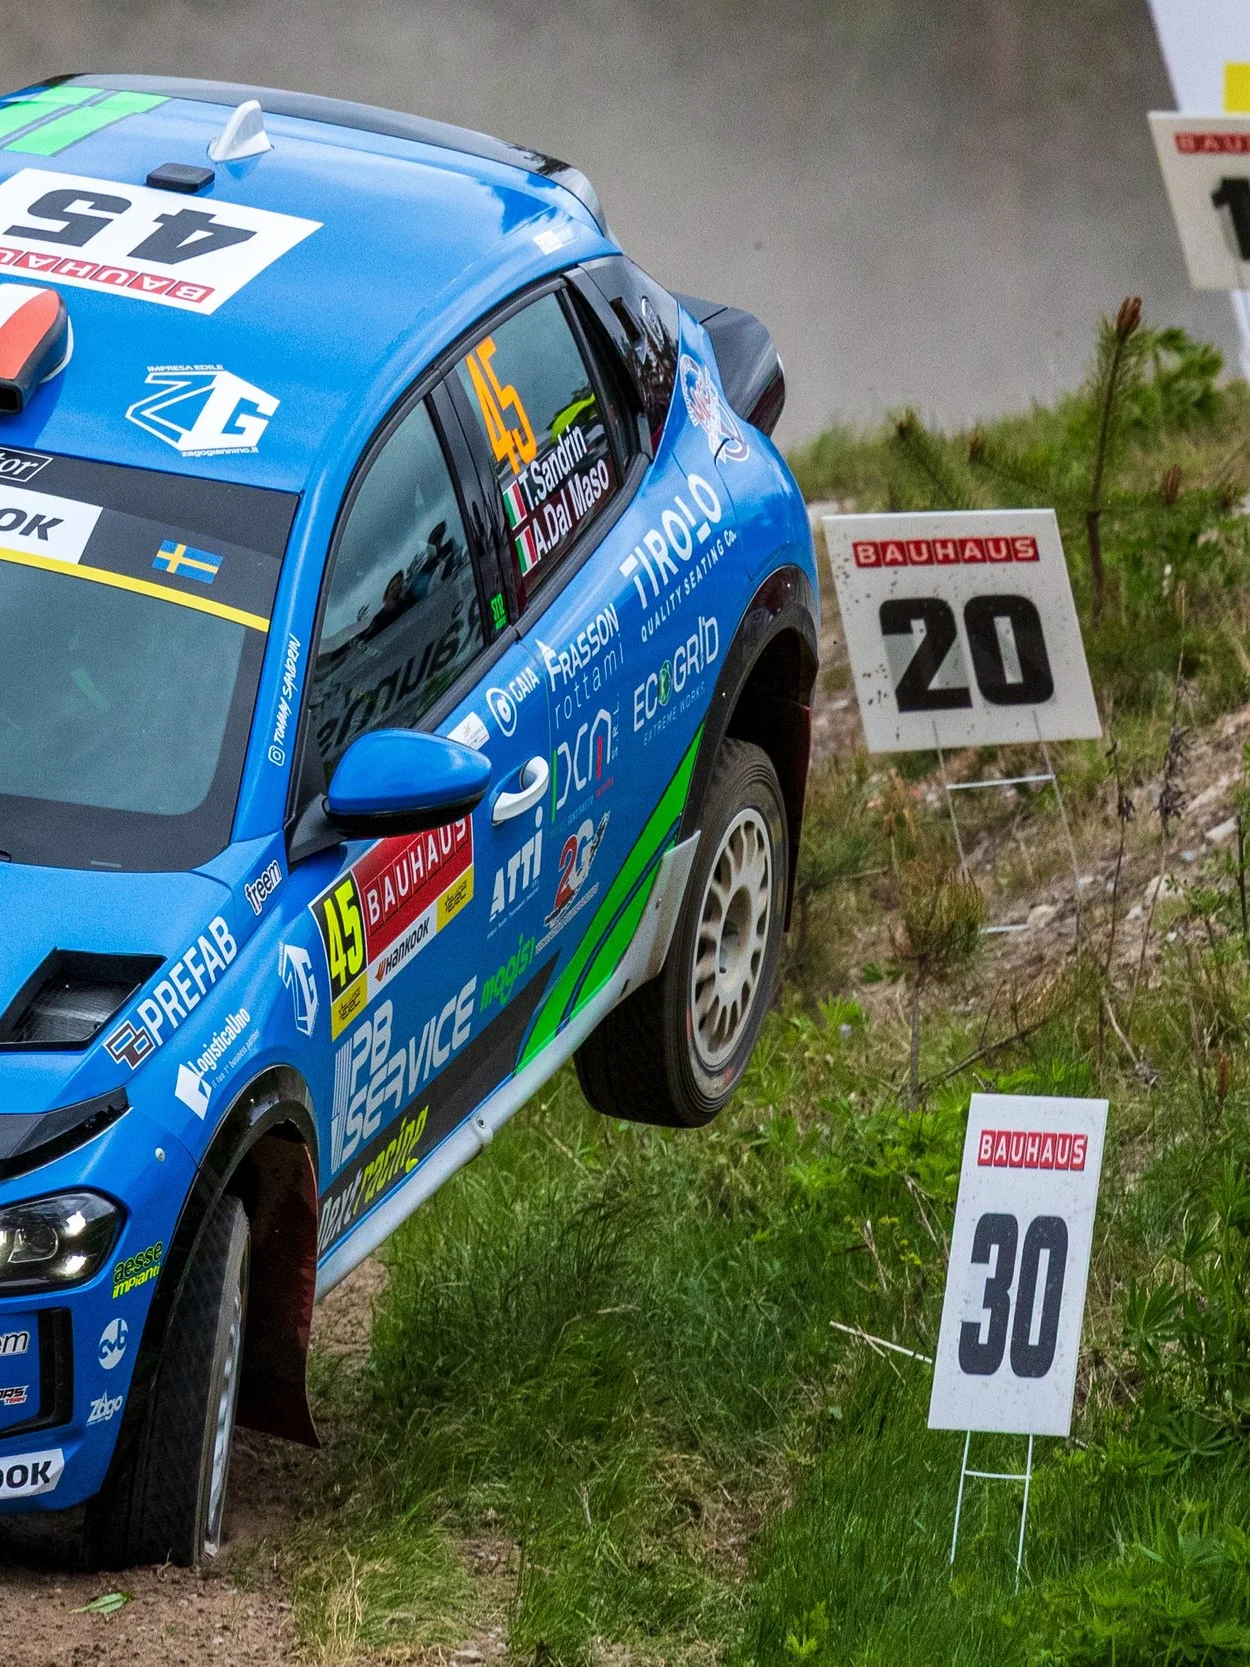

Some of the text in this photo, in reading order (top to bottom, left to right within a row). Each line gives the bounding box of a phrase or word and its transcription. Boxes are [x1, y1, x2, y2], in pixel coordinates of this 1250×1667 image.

[3, 189, 257, 264] 45
[147, 364, 192, 372] IMPRESA
[466, 336, 538, 475] 45
[517, 425, 587, 511] T.Sandrin
[570, 459, 609, 526] Maso
[855, 537, 1038, 566] BAUHAUS
[641, 588, 682, 642] QUALITY
[684, 543, 724, 596] SEATING
[546, 602, 620, 692] FRASSON
[554, 634, 624, 729] rottami
[879, 595, 1054, 713] 20
[509, 667, 540, 703] GAIA
[273, 697, 292, 746] TOMMY
[644, 712, 677, 747] EXTREME
[245, 860, 282, 915] freem
[324, 879, 363, 987] 45
[137, 915, 237, 1046] PREFAB
[188, 1007, 250, 1076] LogisticaUno
[341, 975, 477, 1165] SERVICE
[978, 1132, 1087, 1170] BAUHAUS
[112, 1263, 160, 1299] impianti
[113, 1241, 162, 1284] aesse
[959, 1213, 1068, 1377] 30
